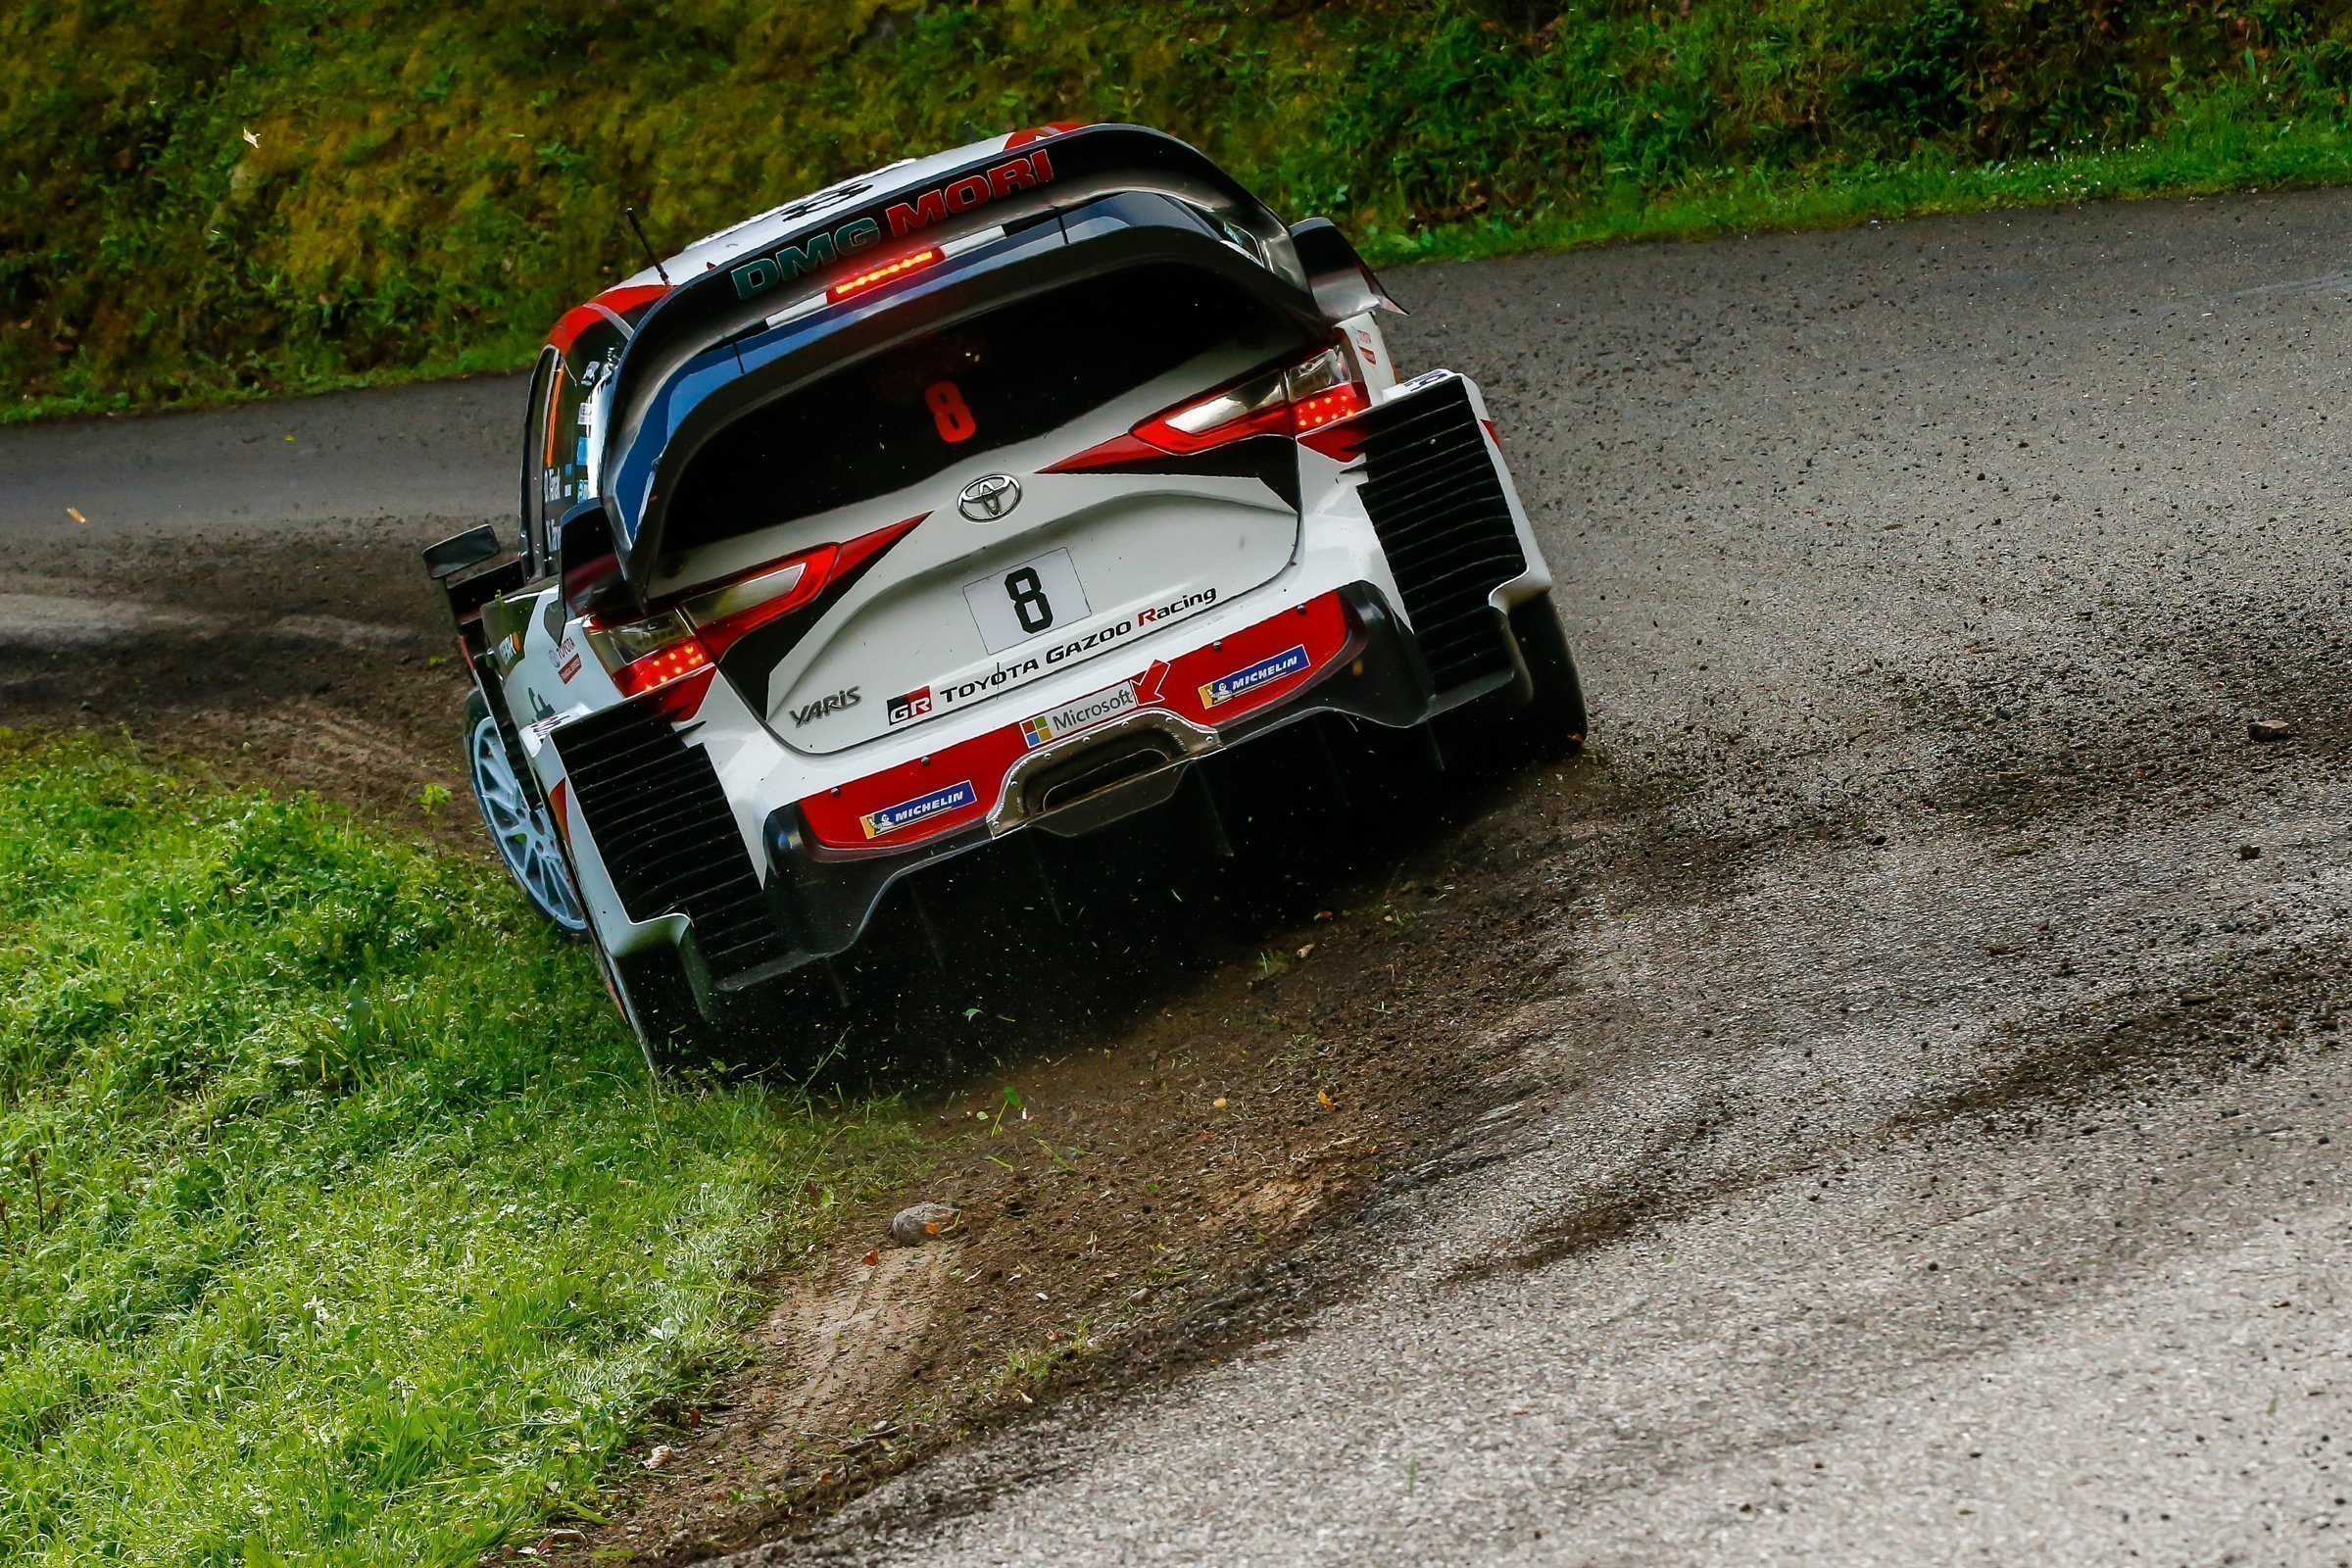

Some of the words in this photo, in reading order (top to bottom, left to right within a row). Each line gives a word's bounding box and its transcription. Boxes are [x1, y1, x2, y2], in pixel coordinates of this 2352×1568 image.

[731, 217, 881, 299] DMG
[885, 149, 1054, 237] MORI
[924, 380, 977, 443] 8
[1004, 565, 1054, 634] 8
[890, 697, 932, 724] GR
[940, 659, 1039, 703] TOYOTA
[1046, 620, 1132, 664] GAZOO
[1138, 588, 1216, 627] Racing
[1232, 656, 1298, 690] MICHELIN
[1053, 689, 1133, 731] Microsoft
[895, 791, 964, 822] MICHELIN
